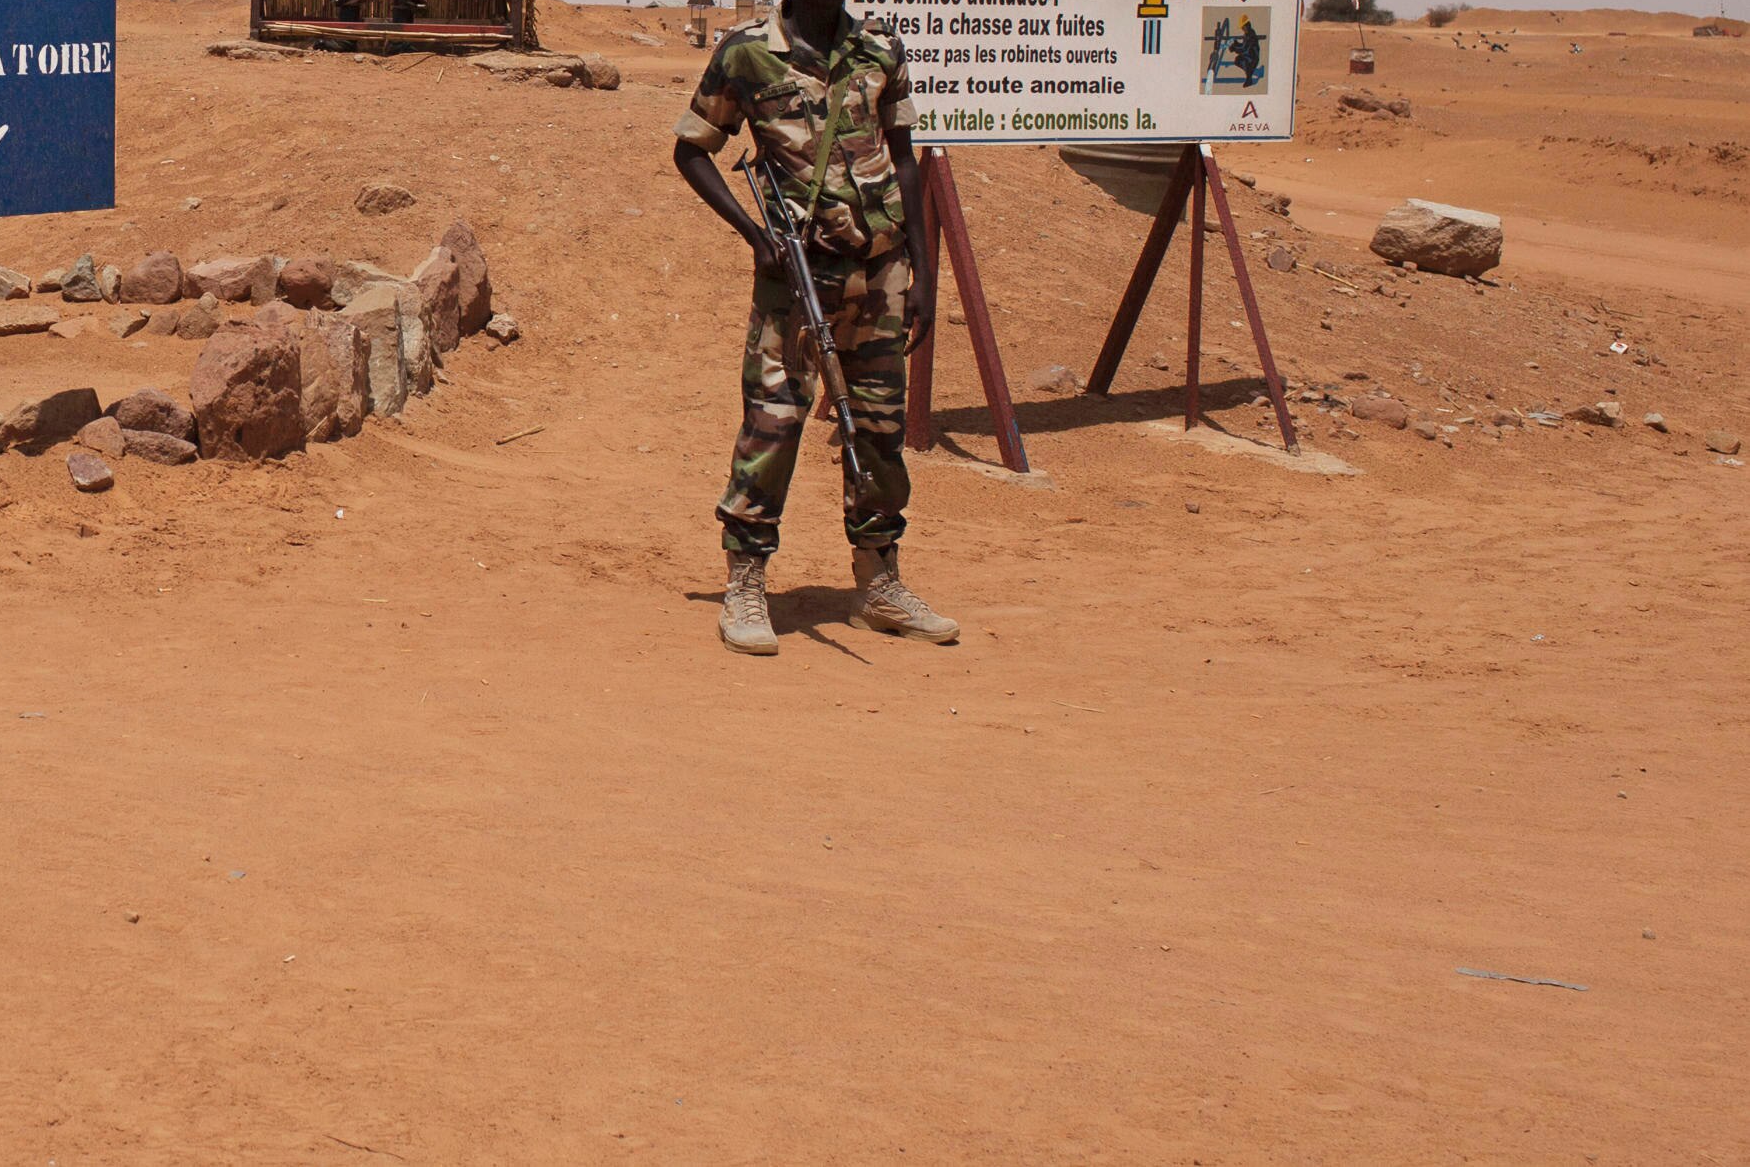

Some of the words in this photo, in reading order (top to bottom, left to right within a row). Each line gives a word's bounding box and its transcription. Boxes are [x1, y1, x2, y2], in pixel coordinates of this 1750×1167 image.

[864, 11, 920, 35] ites
[927, 12, 943, 35] la
[949, 12, 1012, 35] chasse
[1018, 18, 1051, 36] aux
[1056, 14, 1105, 36] fuites
[906, 48, 939, 63] ssez
[944, 47, 970, 67] pas
[975, 44, 996, 63] les
[1001, 44, 1061, 64] robinets
[1066, 48, 1118, 64] ouverts
[967, 76, 1023, 94] toute
[1030, 76, 1125, 95] anomalie
[943, 108, 995, 131] vitale
[1011, 107, 1129, 131] économisons
[1136, 107, 1157, 130] la.
[1229, 123, 1270, 132] AREVA
